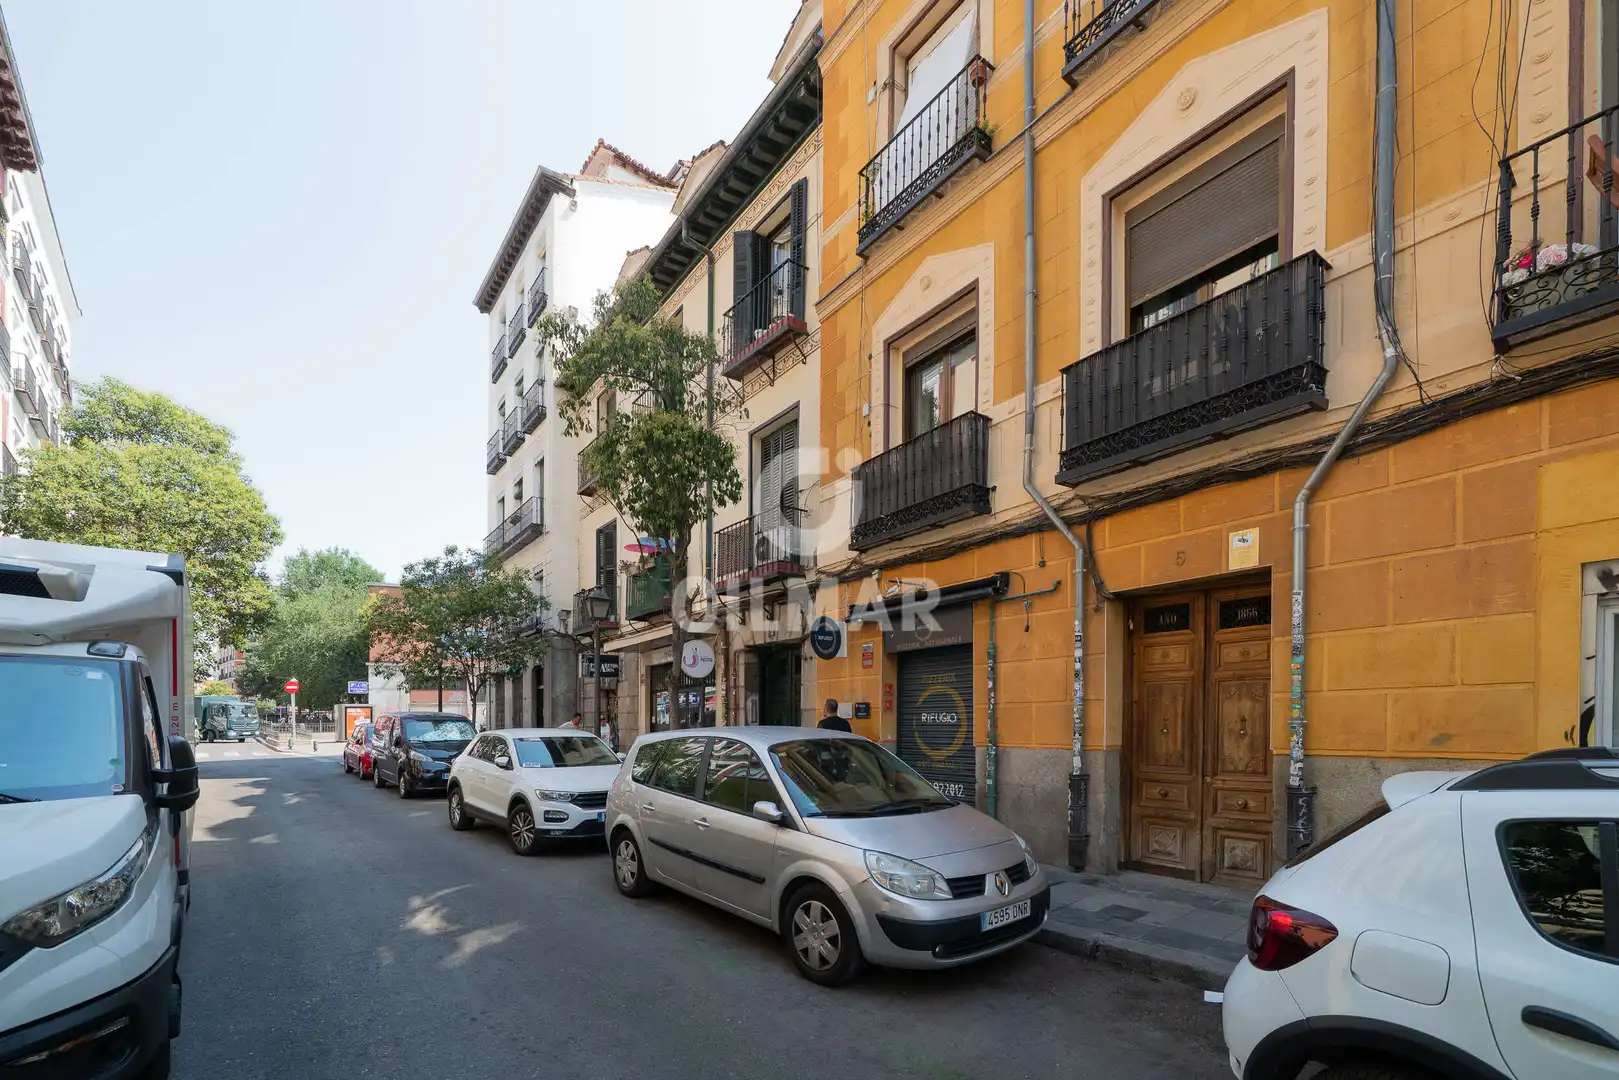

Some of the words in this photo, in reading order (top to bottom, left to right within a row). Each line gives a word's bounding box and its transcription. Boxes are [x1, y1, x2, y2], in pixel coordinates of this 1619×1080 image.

[1175, 550, 1187, 567] 5
[921, 712, 957, 723] RIFUGIO
[988, 907, 1011, 927] 4595
[1012, 901, 1029, 919] DNR
